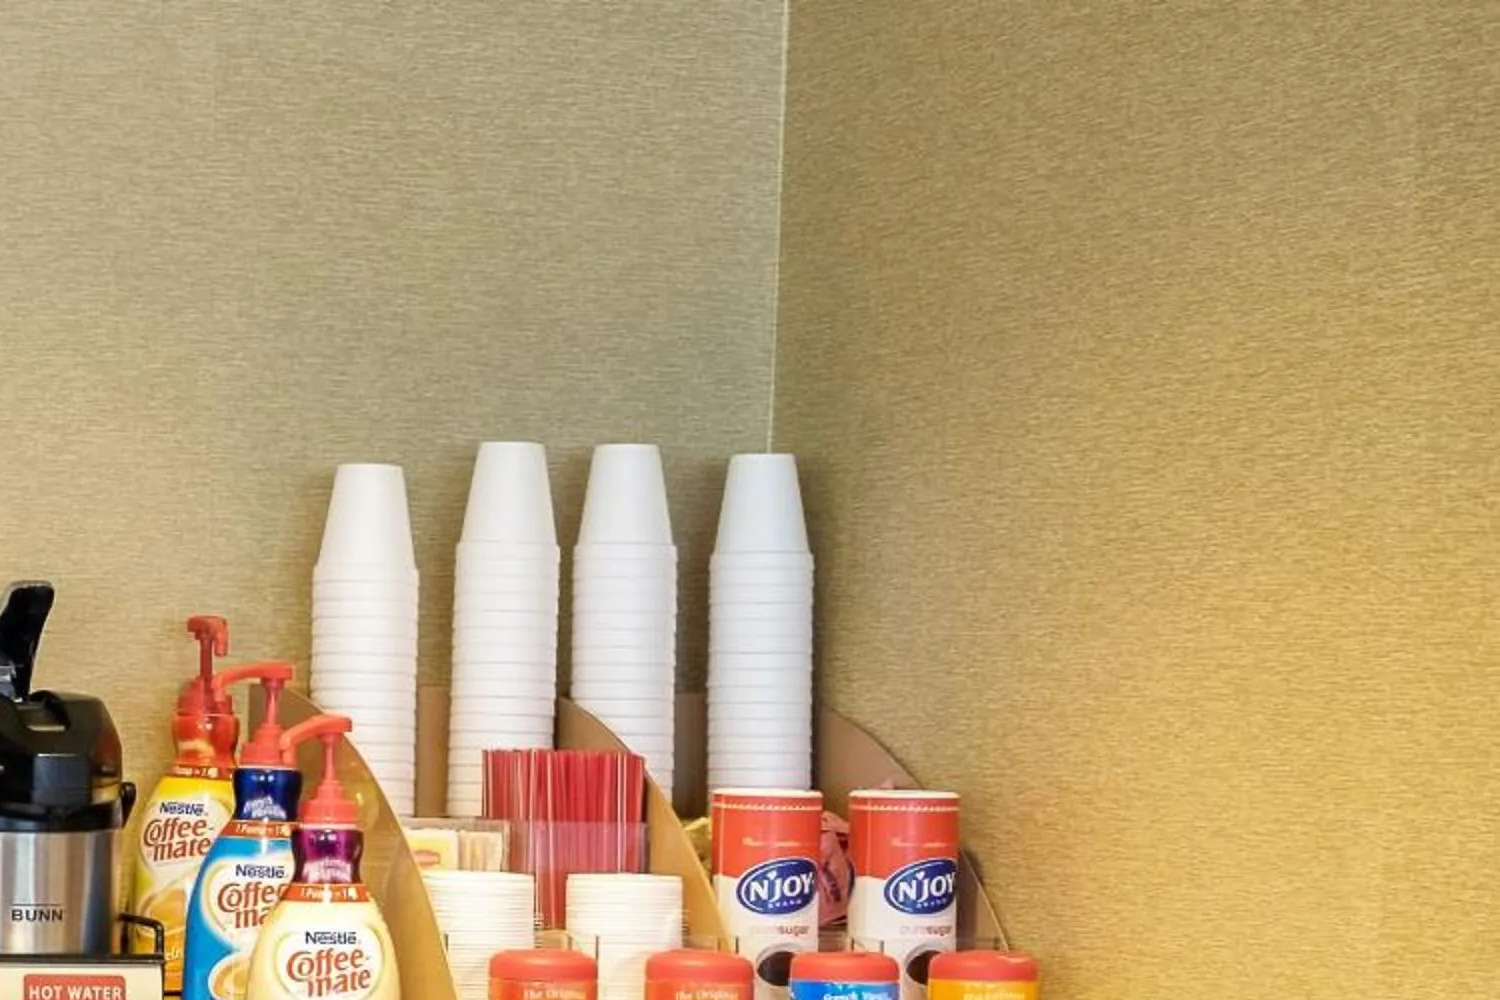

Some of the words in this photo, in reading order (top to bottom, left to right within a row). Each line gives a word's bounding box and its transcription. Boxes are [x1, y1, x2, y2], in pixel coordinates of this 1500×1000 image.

[11, 908, 63, 921] BUNN
[307, 968, 372, 998] mate
[28, 984, 63, 1000] HOT
[67, 984, 124, 1000] WATER
